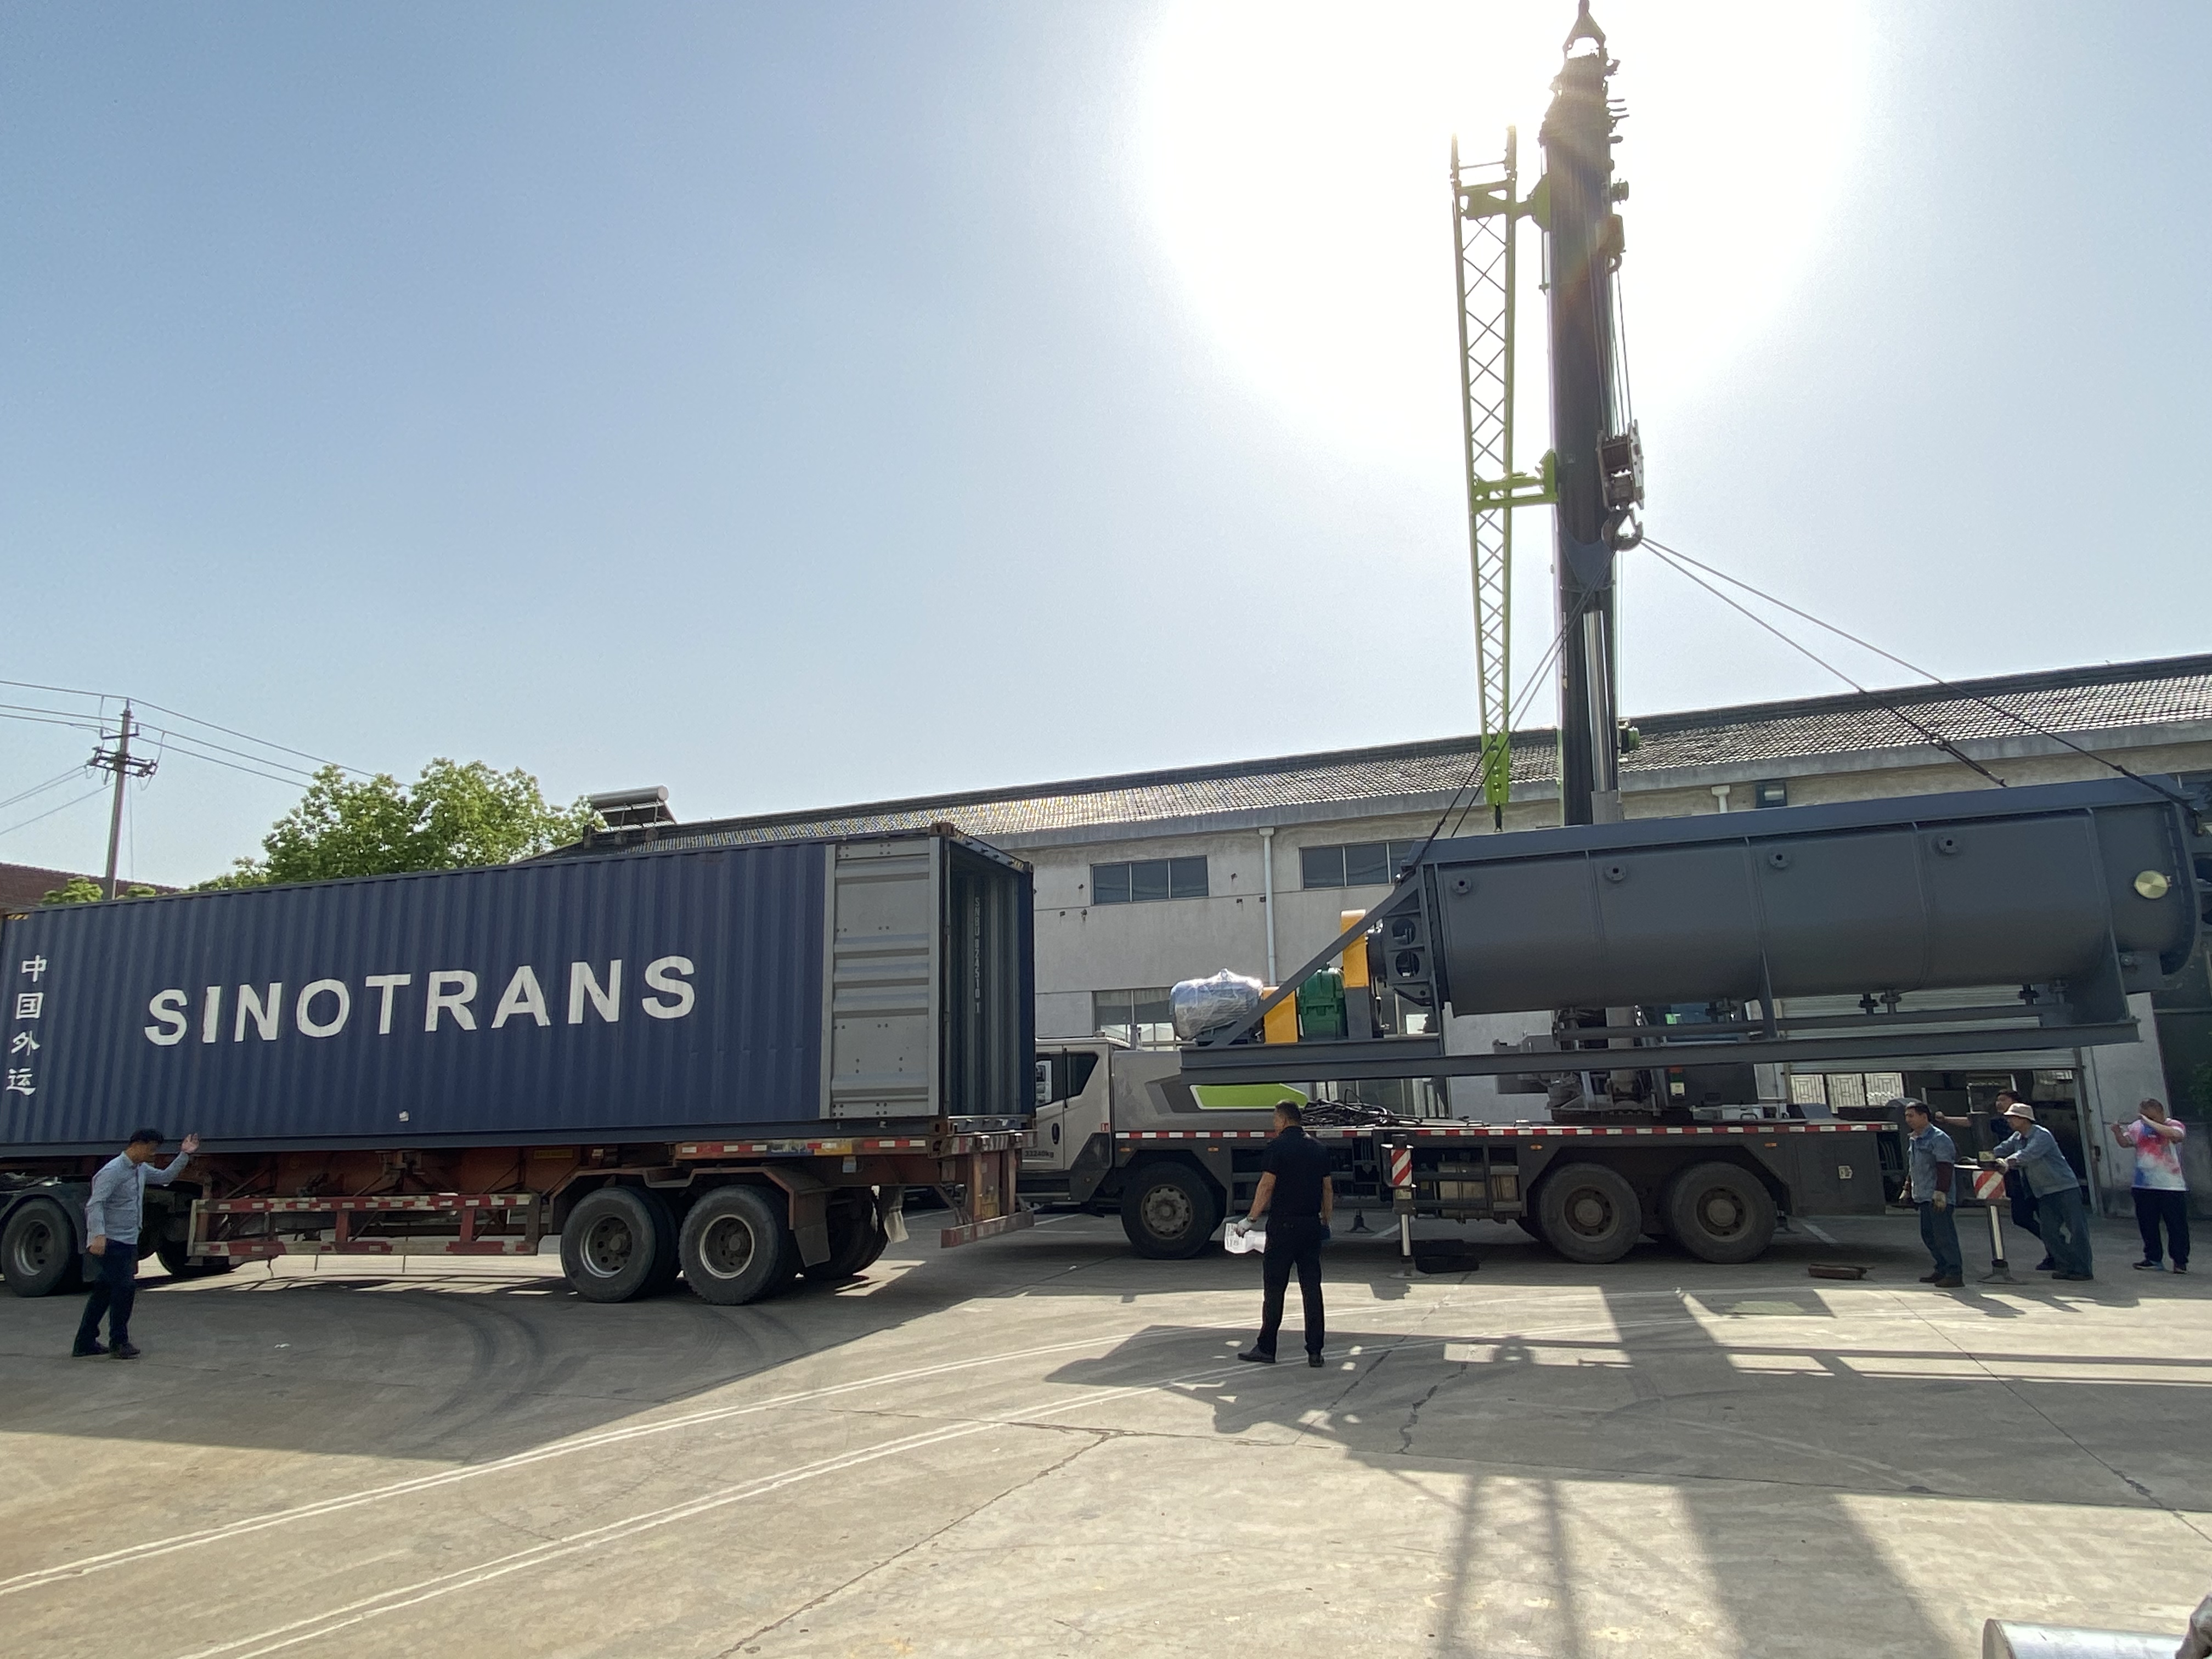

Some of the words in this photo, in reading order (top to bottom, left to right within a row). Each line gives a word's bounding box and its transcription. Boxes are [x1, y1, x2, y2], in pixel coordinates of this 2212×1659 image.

[6, 955, 47, 1096] 中国外运
[144, 956, 695, 1045] SINOTRANS
